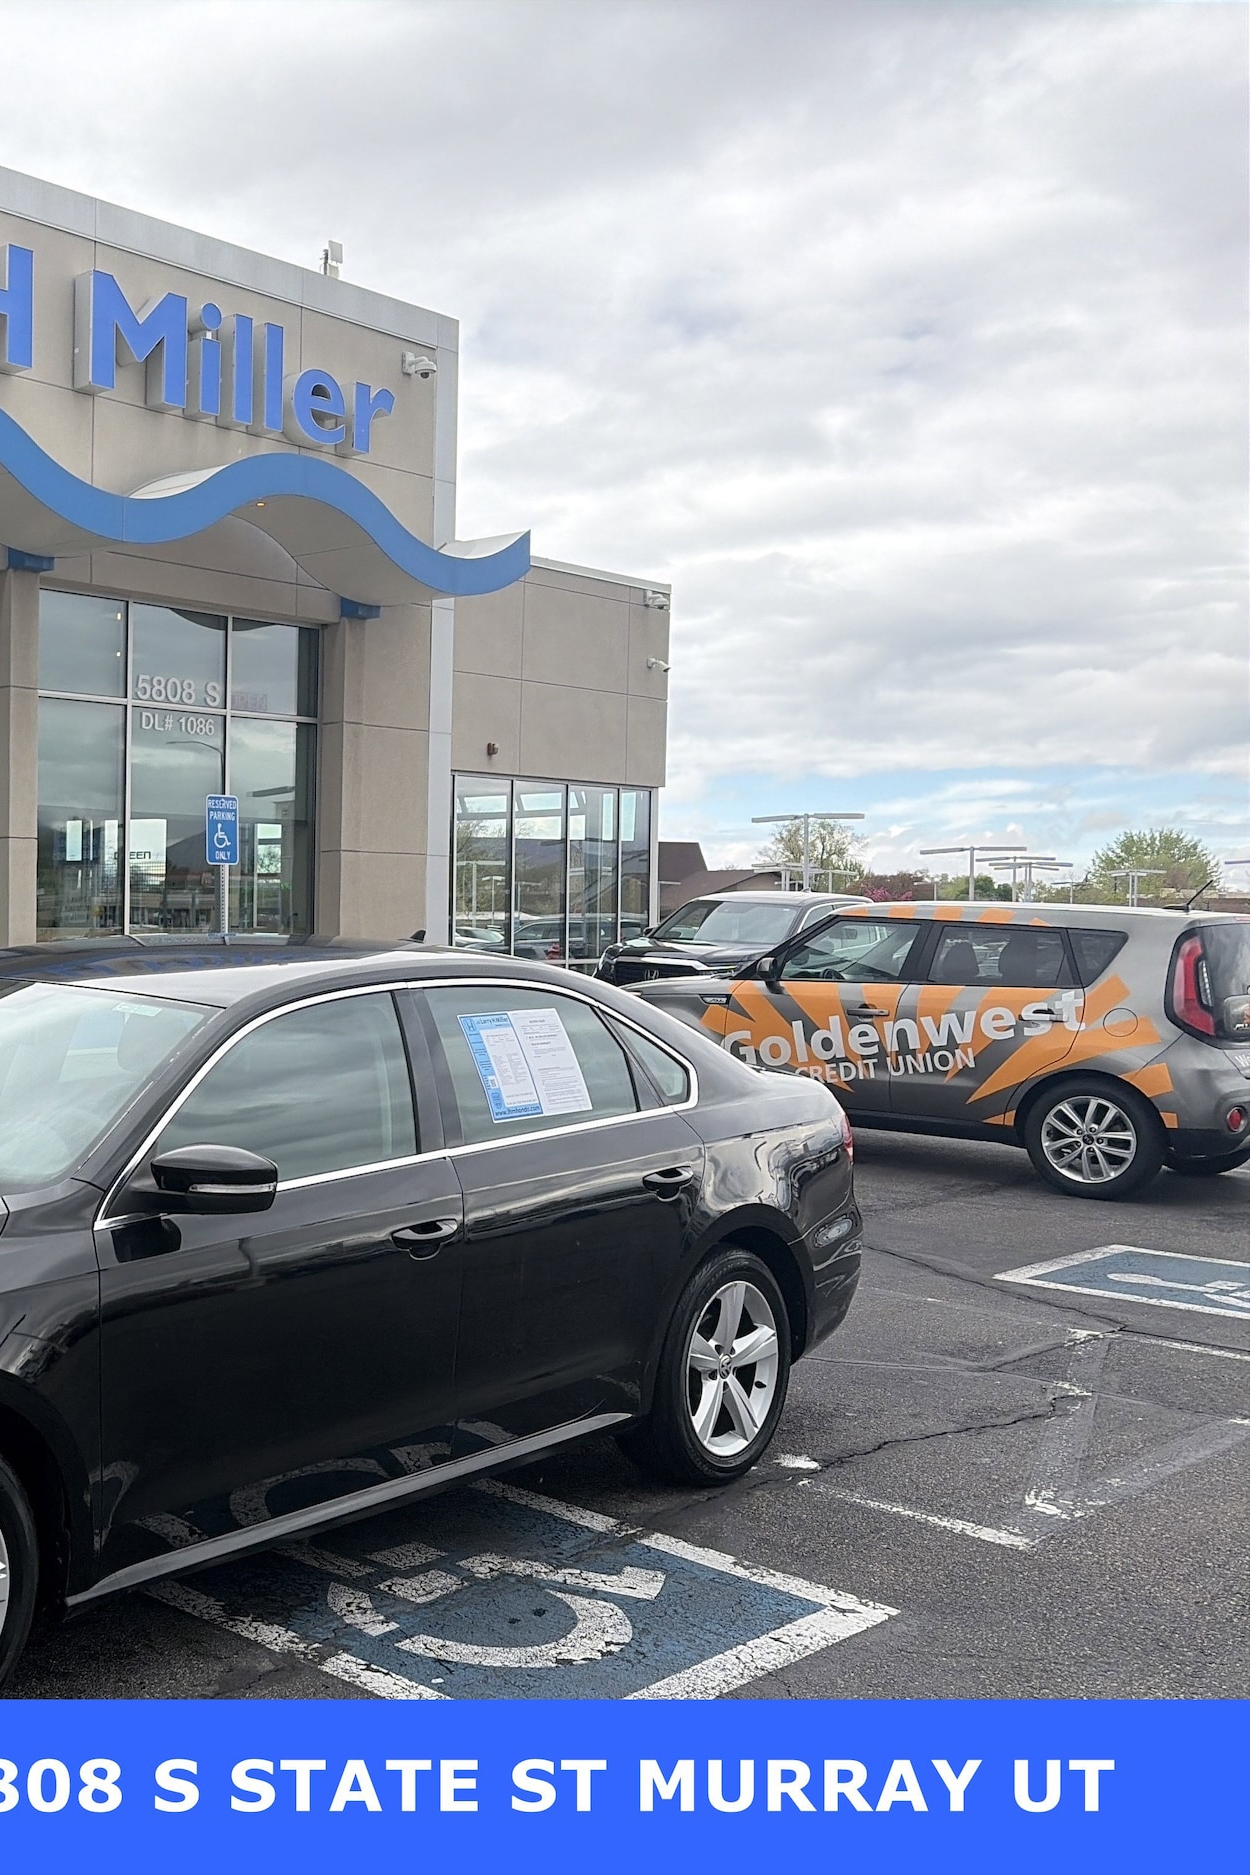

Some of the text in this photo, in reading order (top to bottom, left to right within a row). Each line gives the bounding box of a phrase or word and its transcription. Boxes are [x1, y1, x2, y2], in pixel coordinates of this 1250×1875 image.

[75, 268, 396, 455] Miller
[136, 674, 220, 706] 5808 S
[141, 711, 215, 736] DL# 1086
[208, 799, 237, 810] RESERVED
[209, 810, 236, 821] PARKING
[215, 850, 231, 860] ONLY
[723, 990, 1087, 1067] Goldenwest
[888, 1047, 976, 1077] UNION
